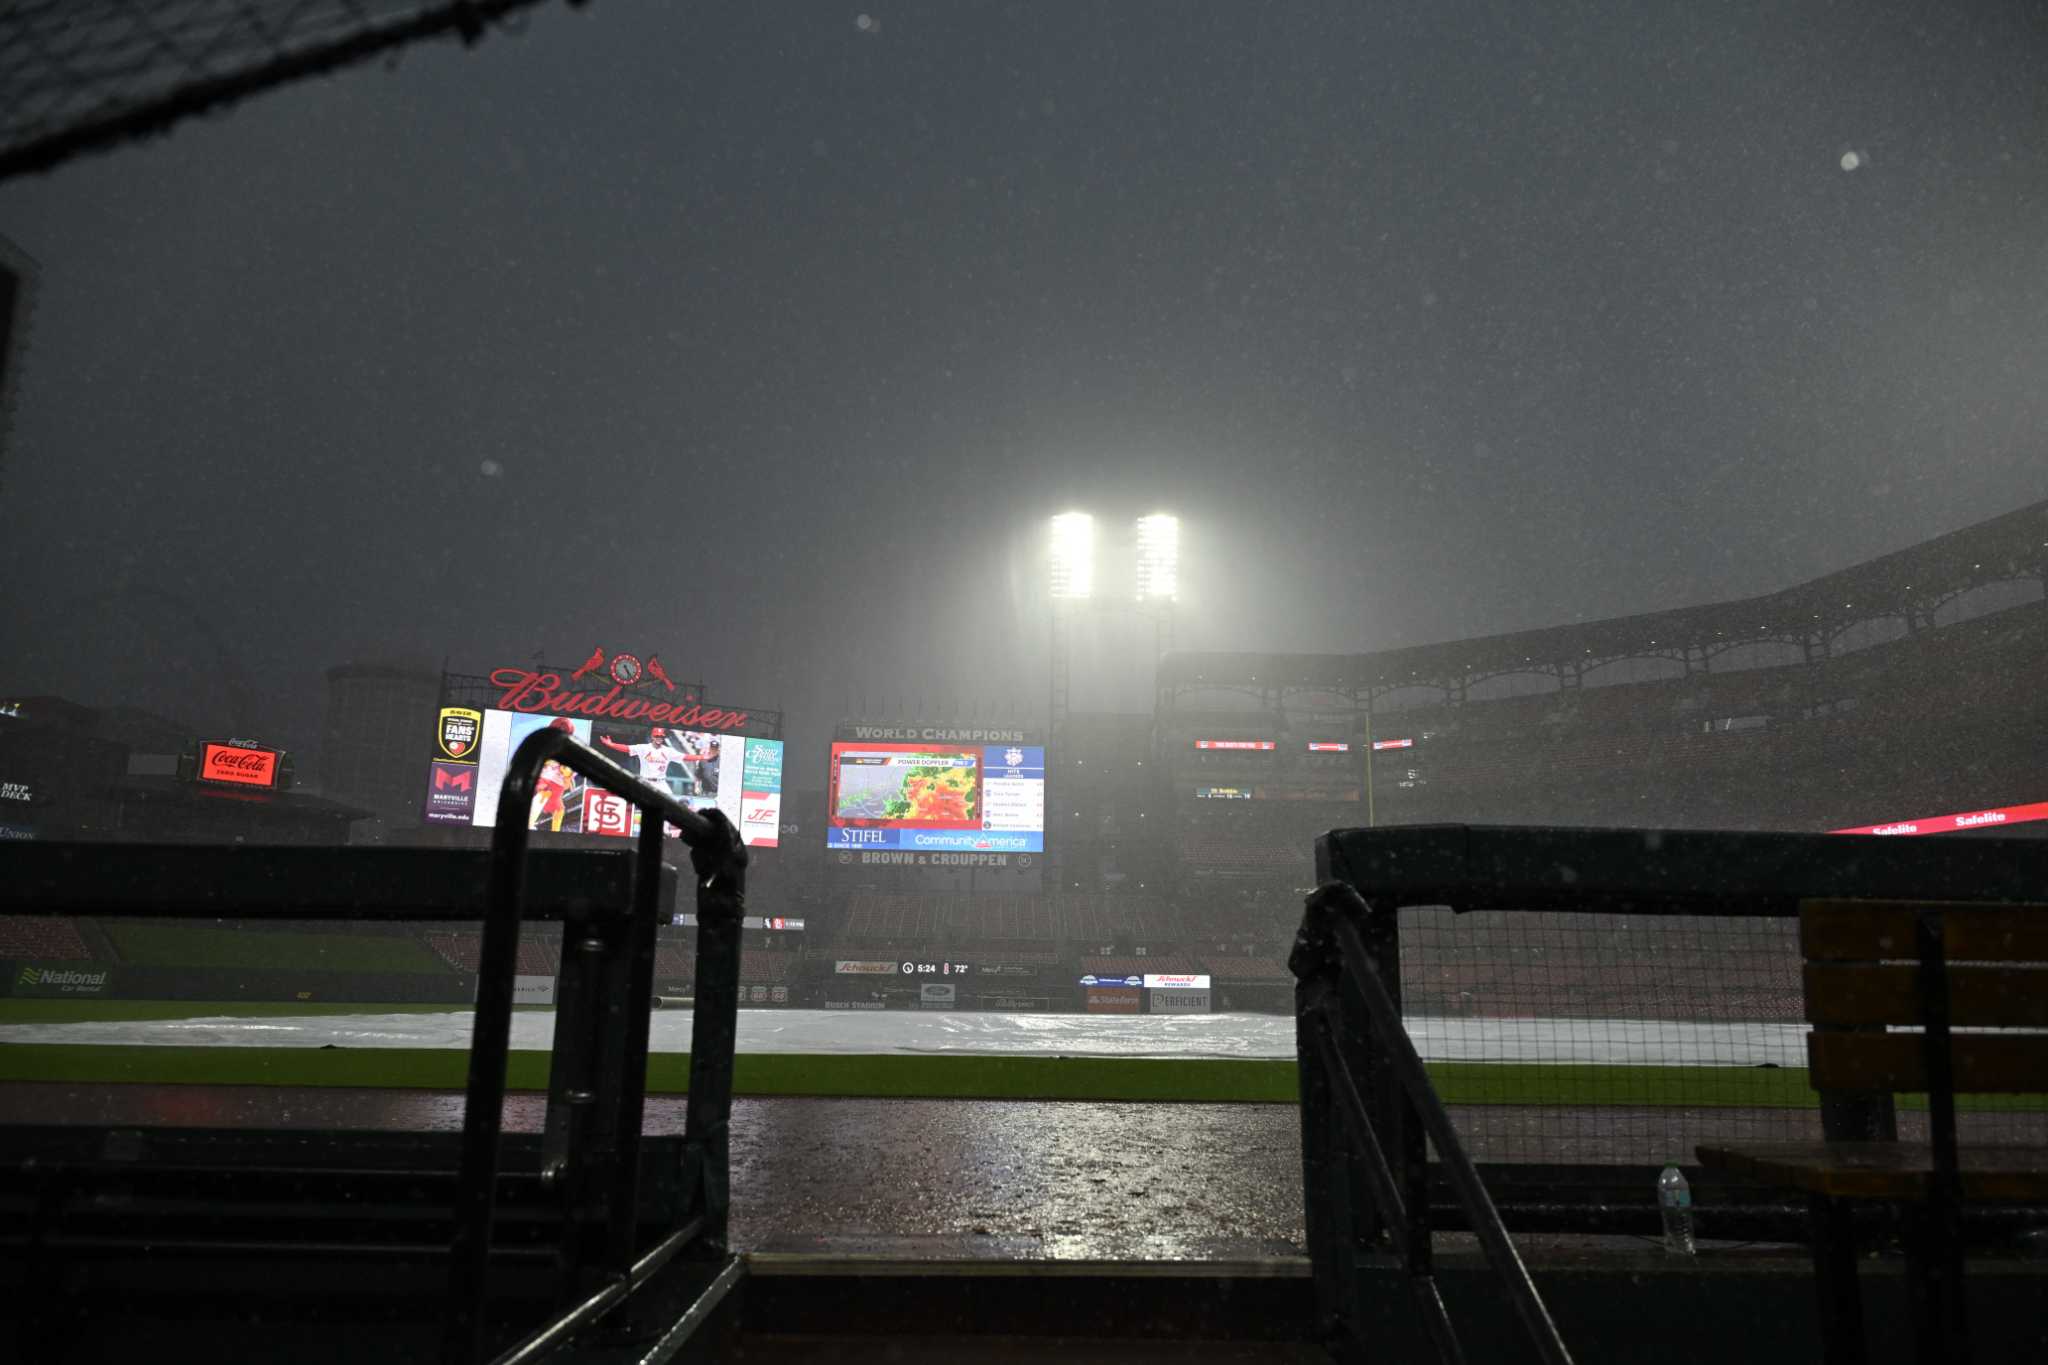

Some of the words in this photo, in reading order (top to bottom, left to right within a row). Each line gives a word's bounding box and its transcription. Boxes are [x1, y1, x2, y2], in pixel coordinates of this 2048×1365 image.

[490, 668, 748, 728] Budweiser
[855, 725, 918, 739] WORLD
[922, 728, 1024, 742] CHAMPIONS
[2, 782, 29, 793] MVP
[0, 790, 32, 801] DECK
[1956, 811, 2006, 827] Safelite
[841, 828, 886, 843] STIFEL
[1872, 823, 1917, 835] Safelite
[862, 852, 914, 865] BROWN
[918, 855, 926, 865] &
[931, 853, 1007, 866] CROUPPEN
[917, 964, 936, 973] 5:24
[40, 969, 107, 985] National
